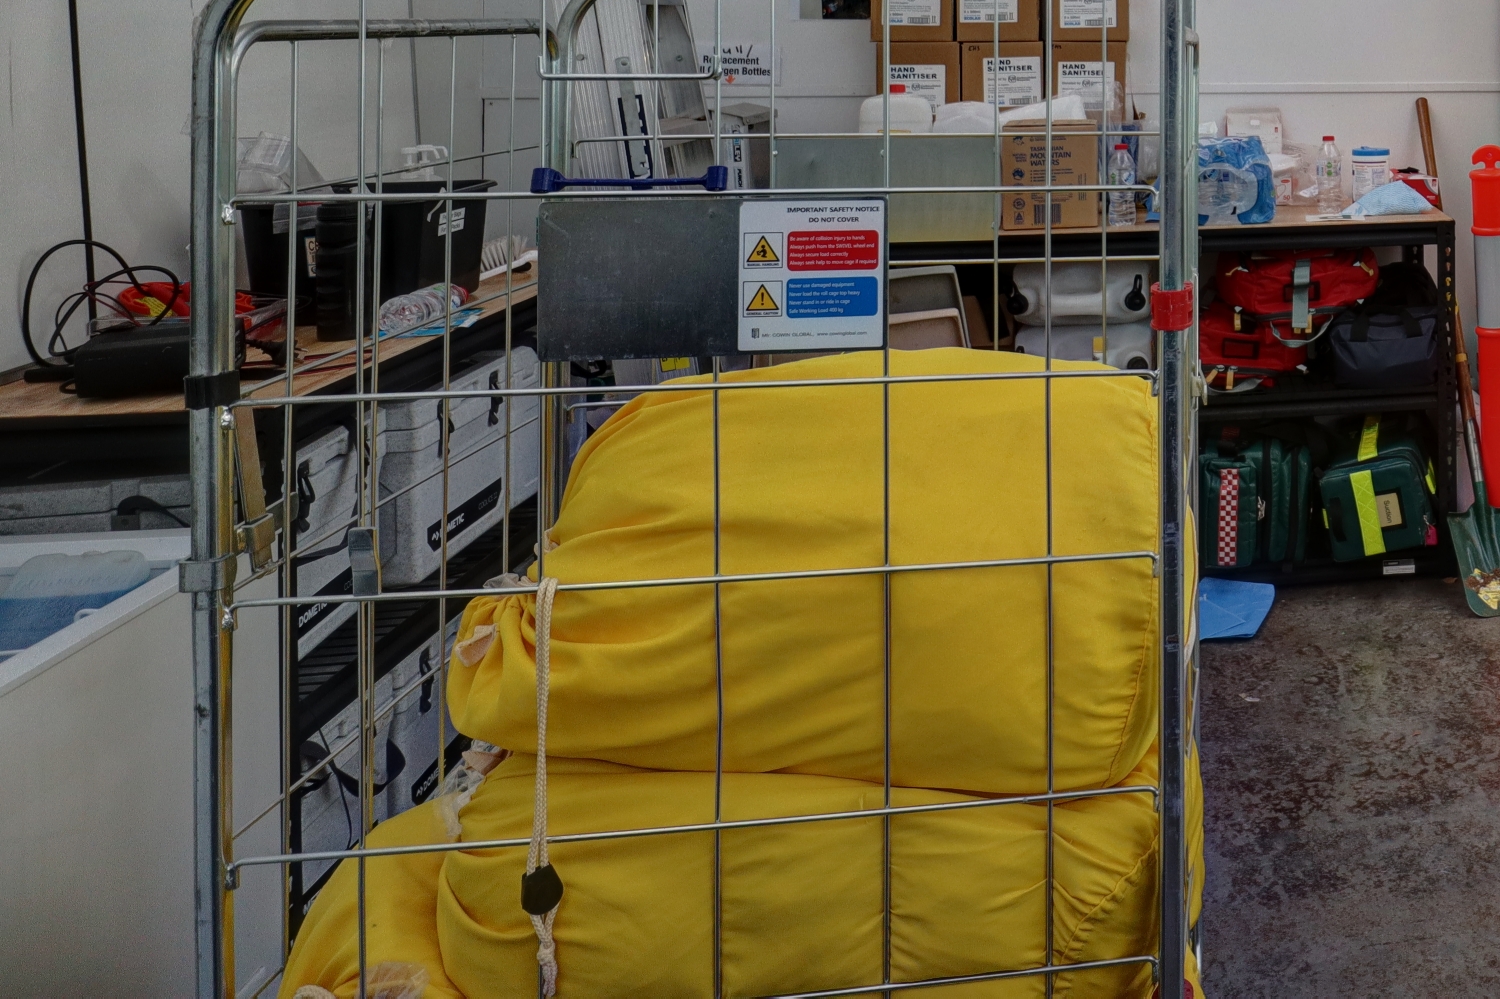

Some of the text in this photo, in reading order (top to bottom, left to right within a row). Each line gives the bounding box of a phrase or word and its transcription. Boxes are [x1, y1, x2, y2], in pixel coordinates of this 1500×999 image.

[742, 67, 771, 76] Bottles
[1384, 500, 1392, 523] Suction
[423, 758, 446, 791] DOME
